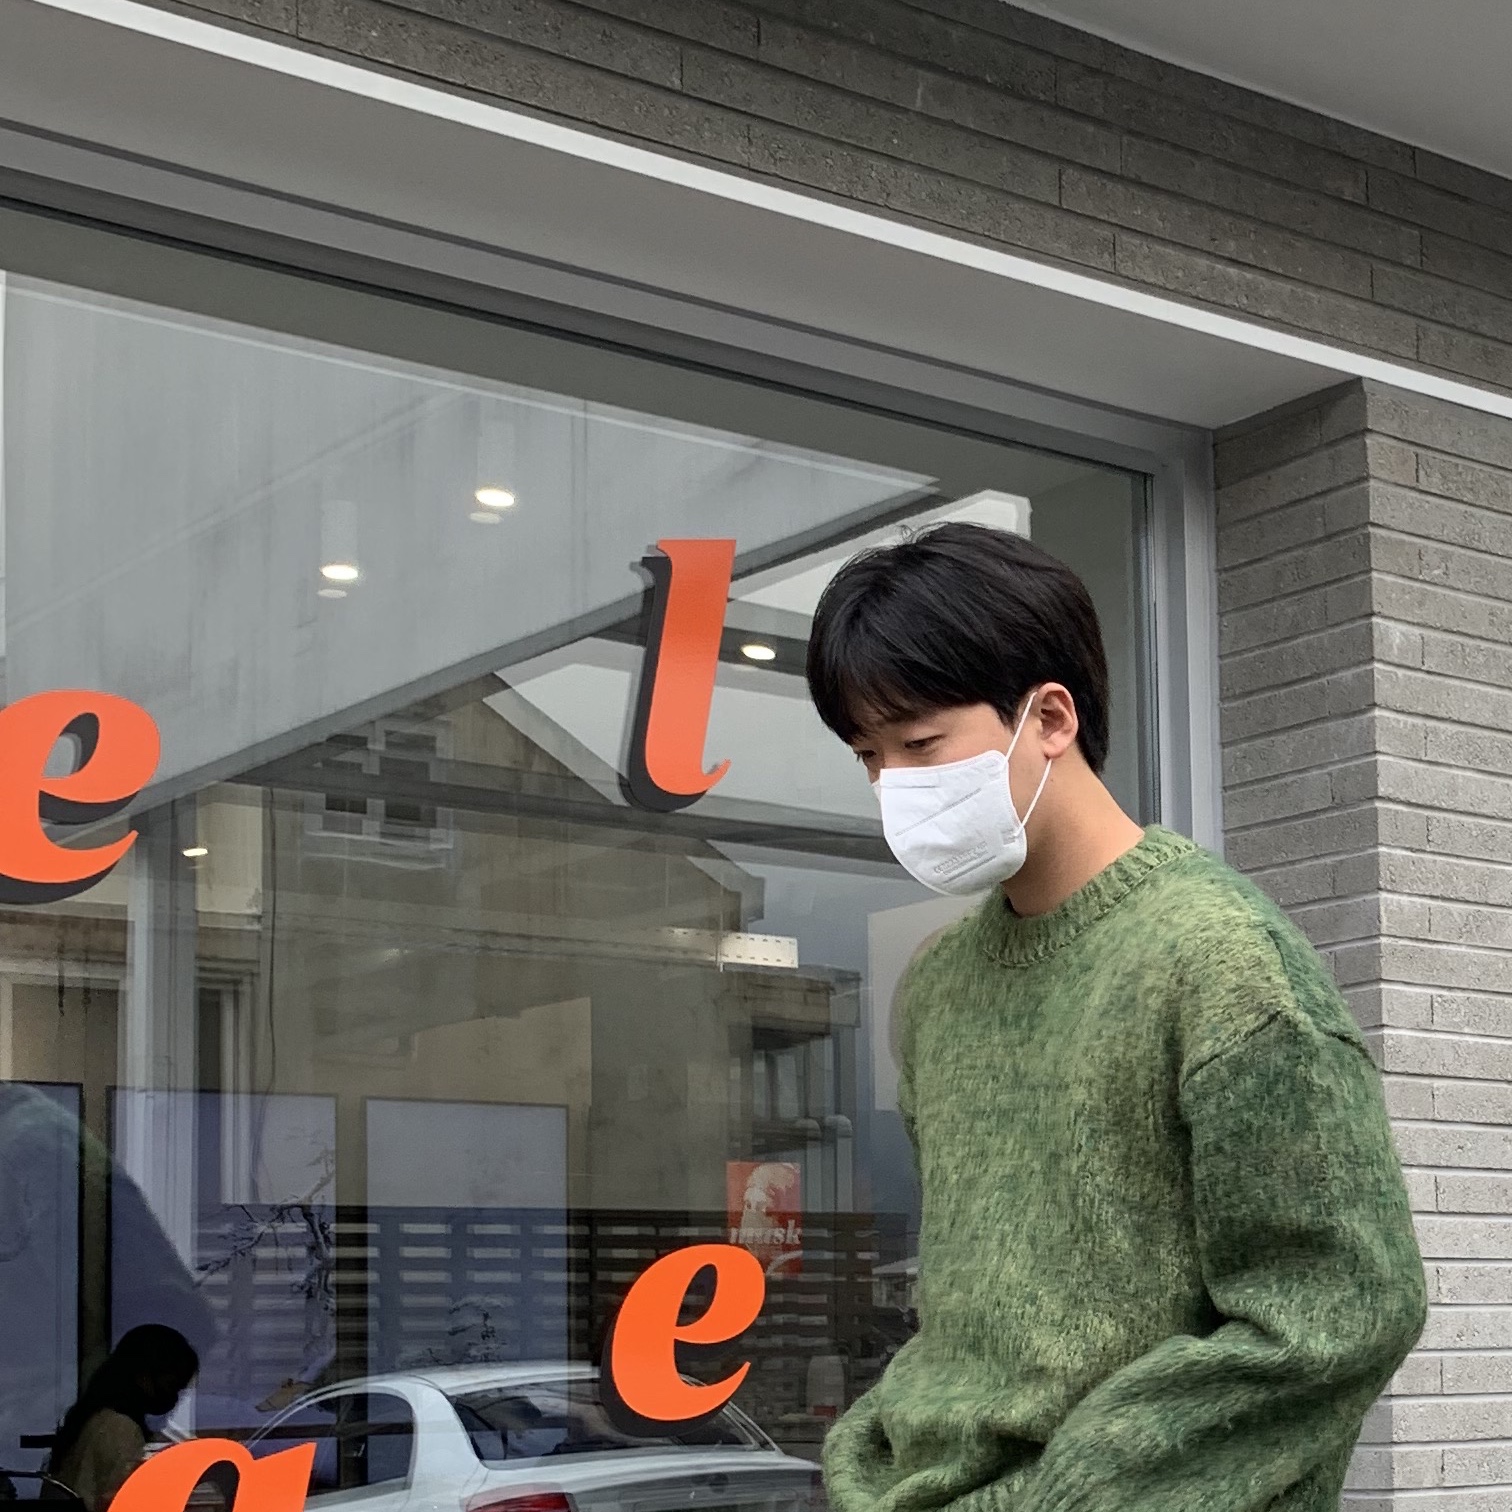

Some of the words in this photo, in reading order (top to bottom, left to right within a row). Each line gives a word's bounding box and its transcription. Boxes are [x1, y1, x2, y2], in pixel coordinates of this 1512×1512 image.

[645, 539, 736, 796] l
[0, 690, 160, 884] e
[611, 1243, 766, 1421] e
